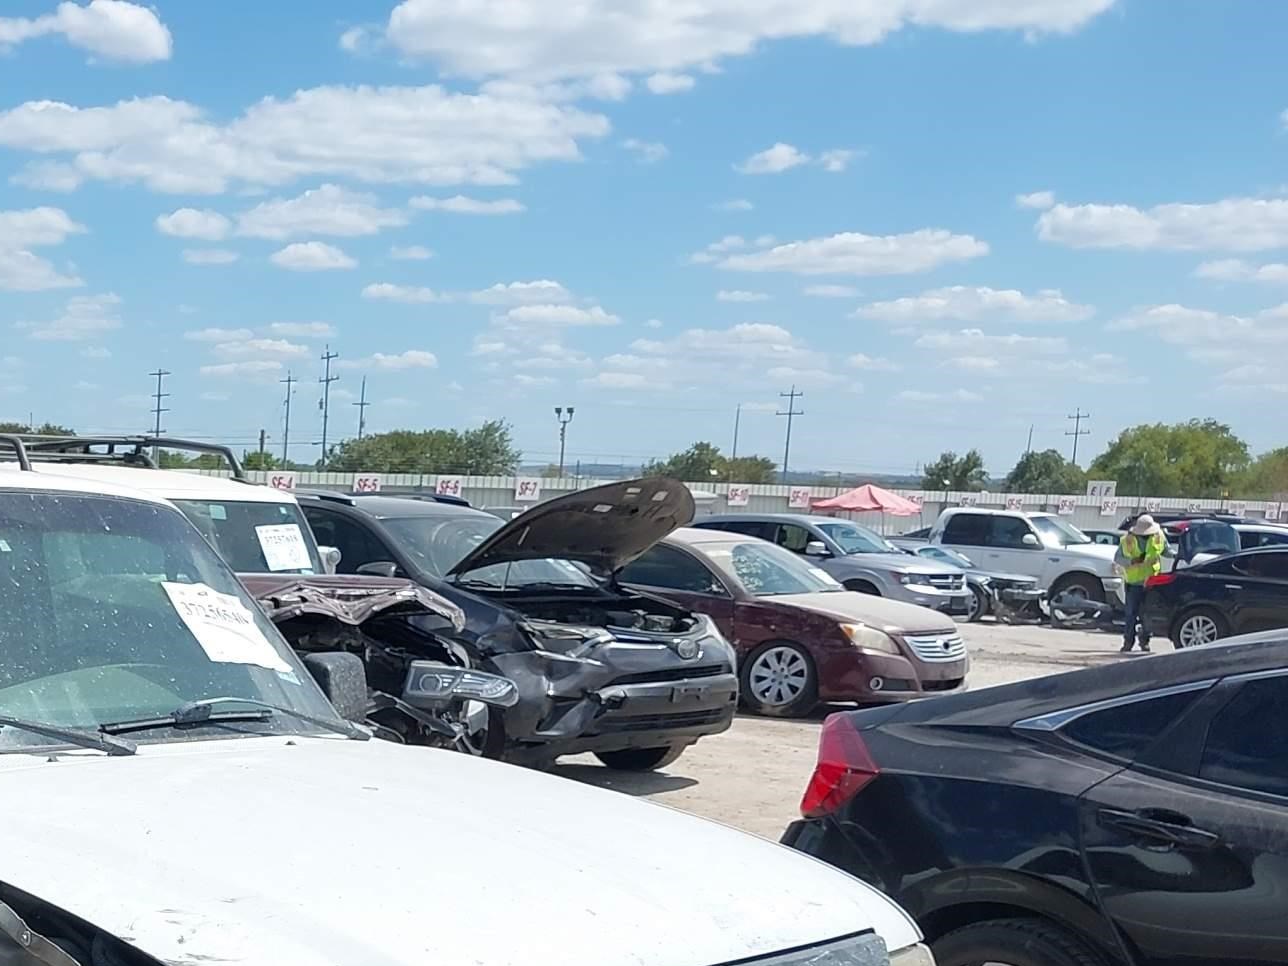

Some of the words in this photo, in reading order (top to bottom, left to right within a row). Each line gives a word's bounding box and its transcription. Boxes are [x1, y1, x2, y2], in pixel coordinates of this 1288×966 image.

[357, 478, 379, 491] SF-5
[438, 480, 460, 494] SF-6
[518, 481, 538, 496] SF-7
